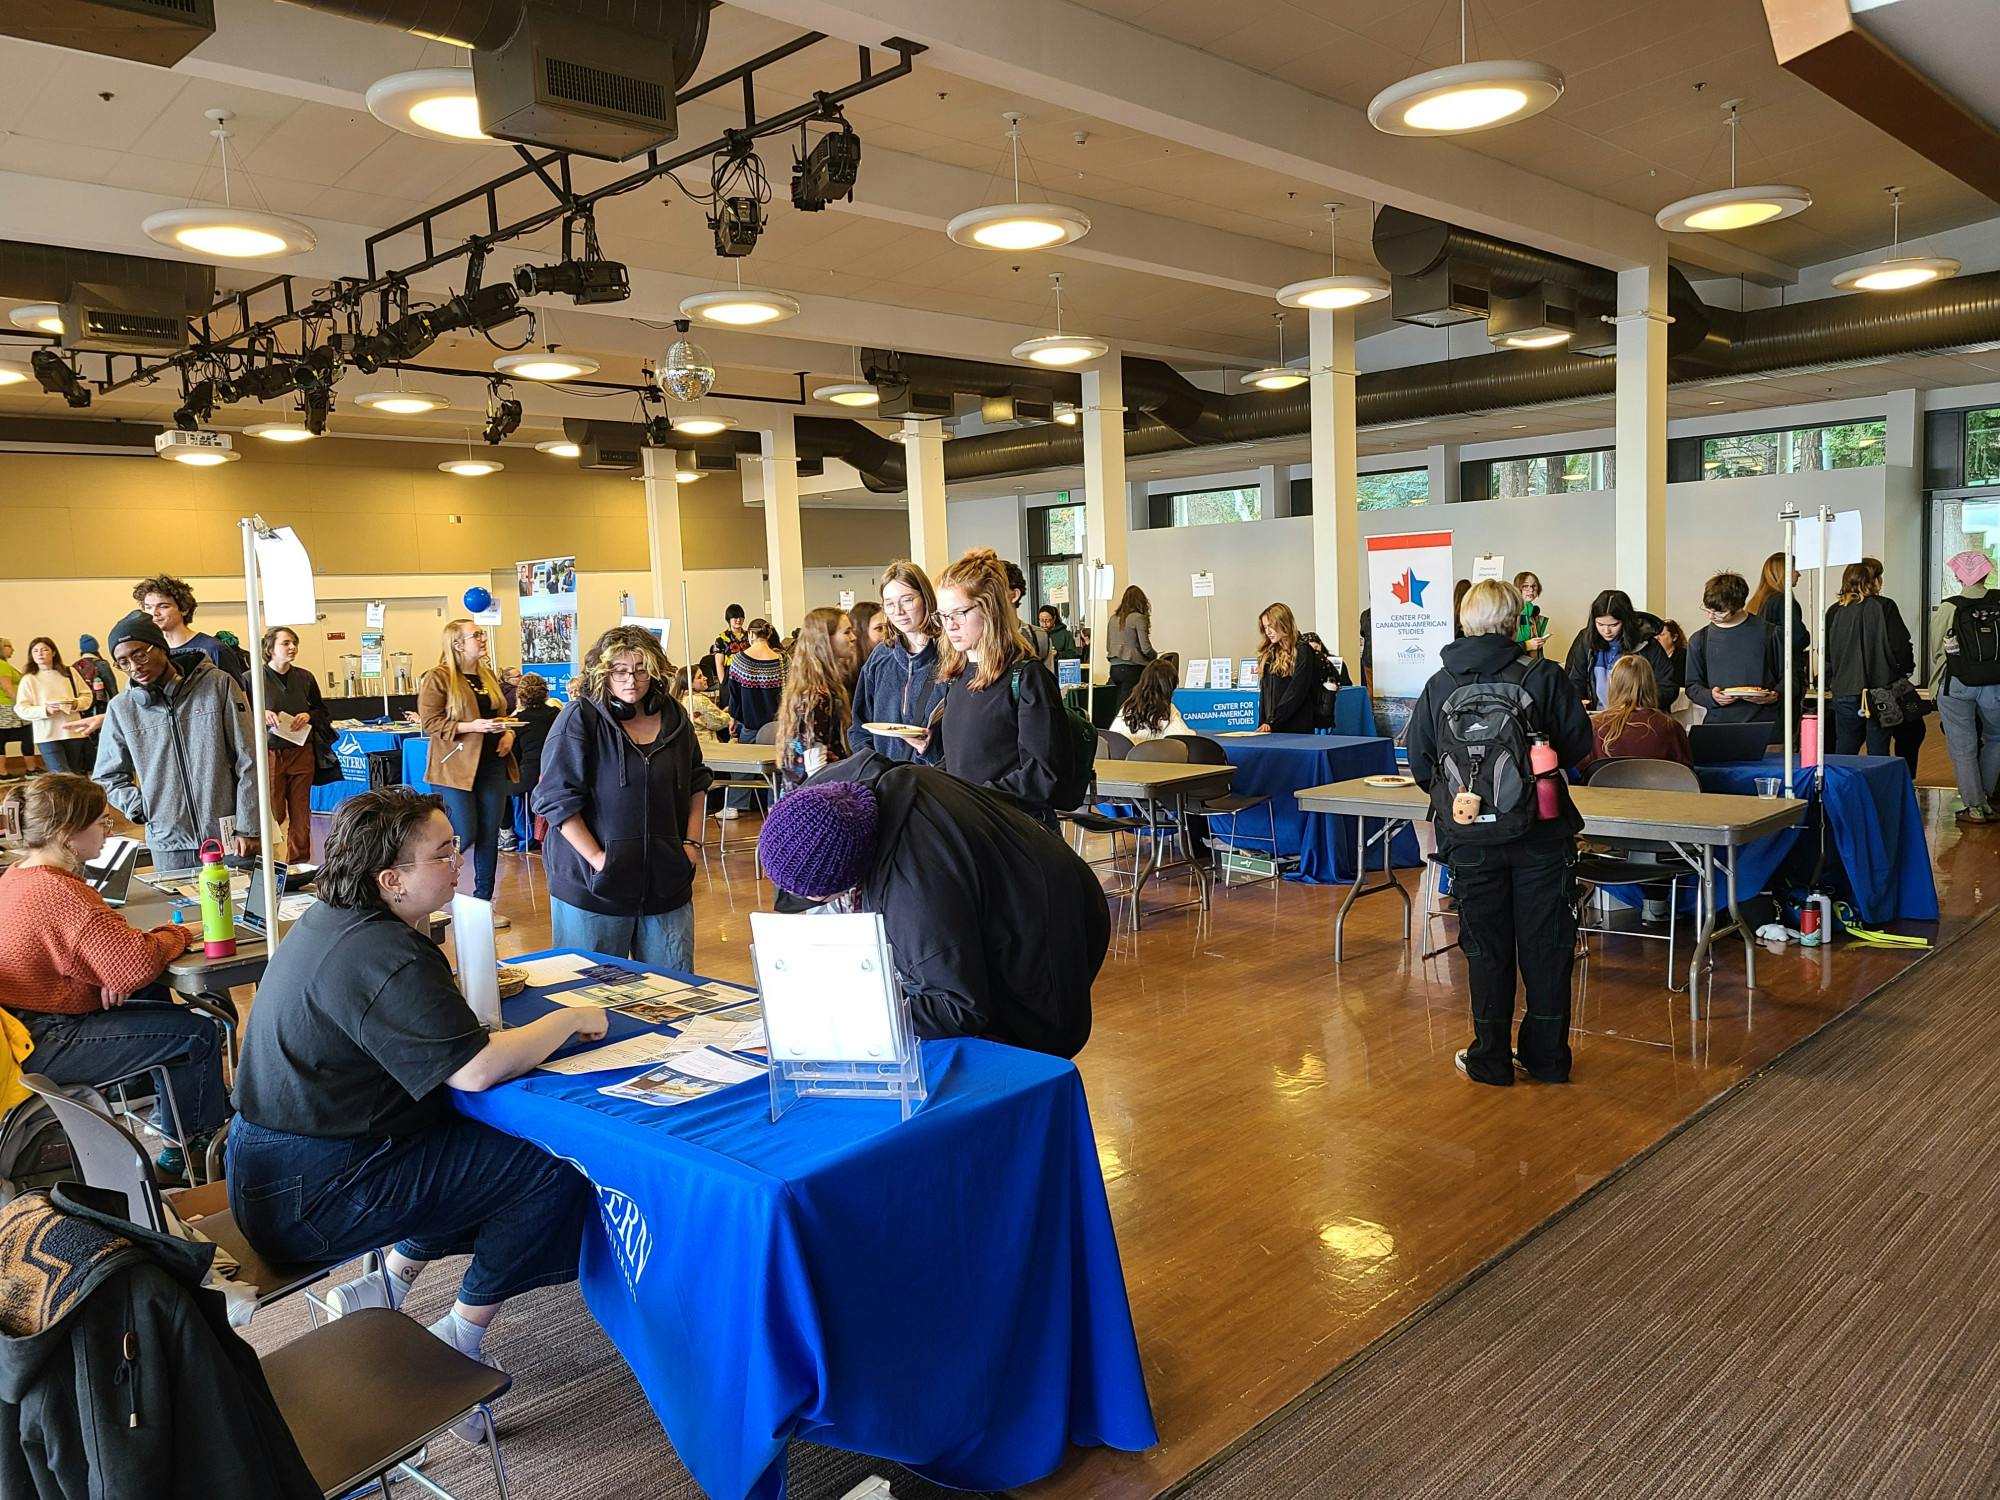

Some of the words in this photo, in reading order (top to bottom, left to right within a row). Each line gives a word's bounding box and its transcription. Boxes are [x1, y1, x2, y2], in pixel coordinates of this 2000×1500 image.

[1376, 620, 1446, 628] CANADIAN-AMERICAN
[1213, 702, 1238, 710] CENTER
[1239, 701, 1254, 709] FOR
[1182, 710, 1254, 720] CANADIAN-AMERICAN
[1227, 717, 1255, 726] STUDIES
